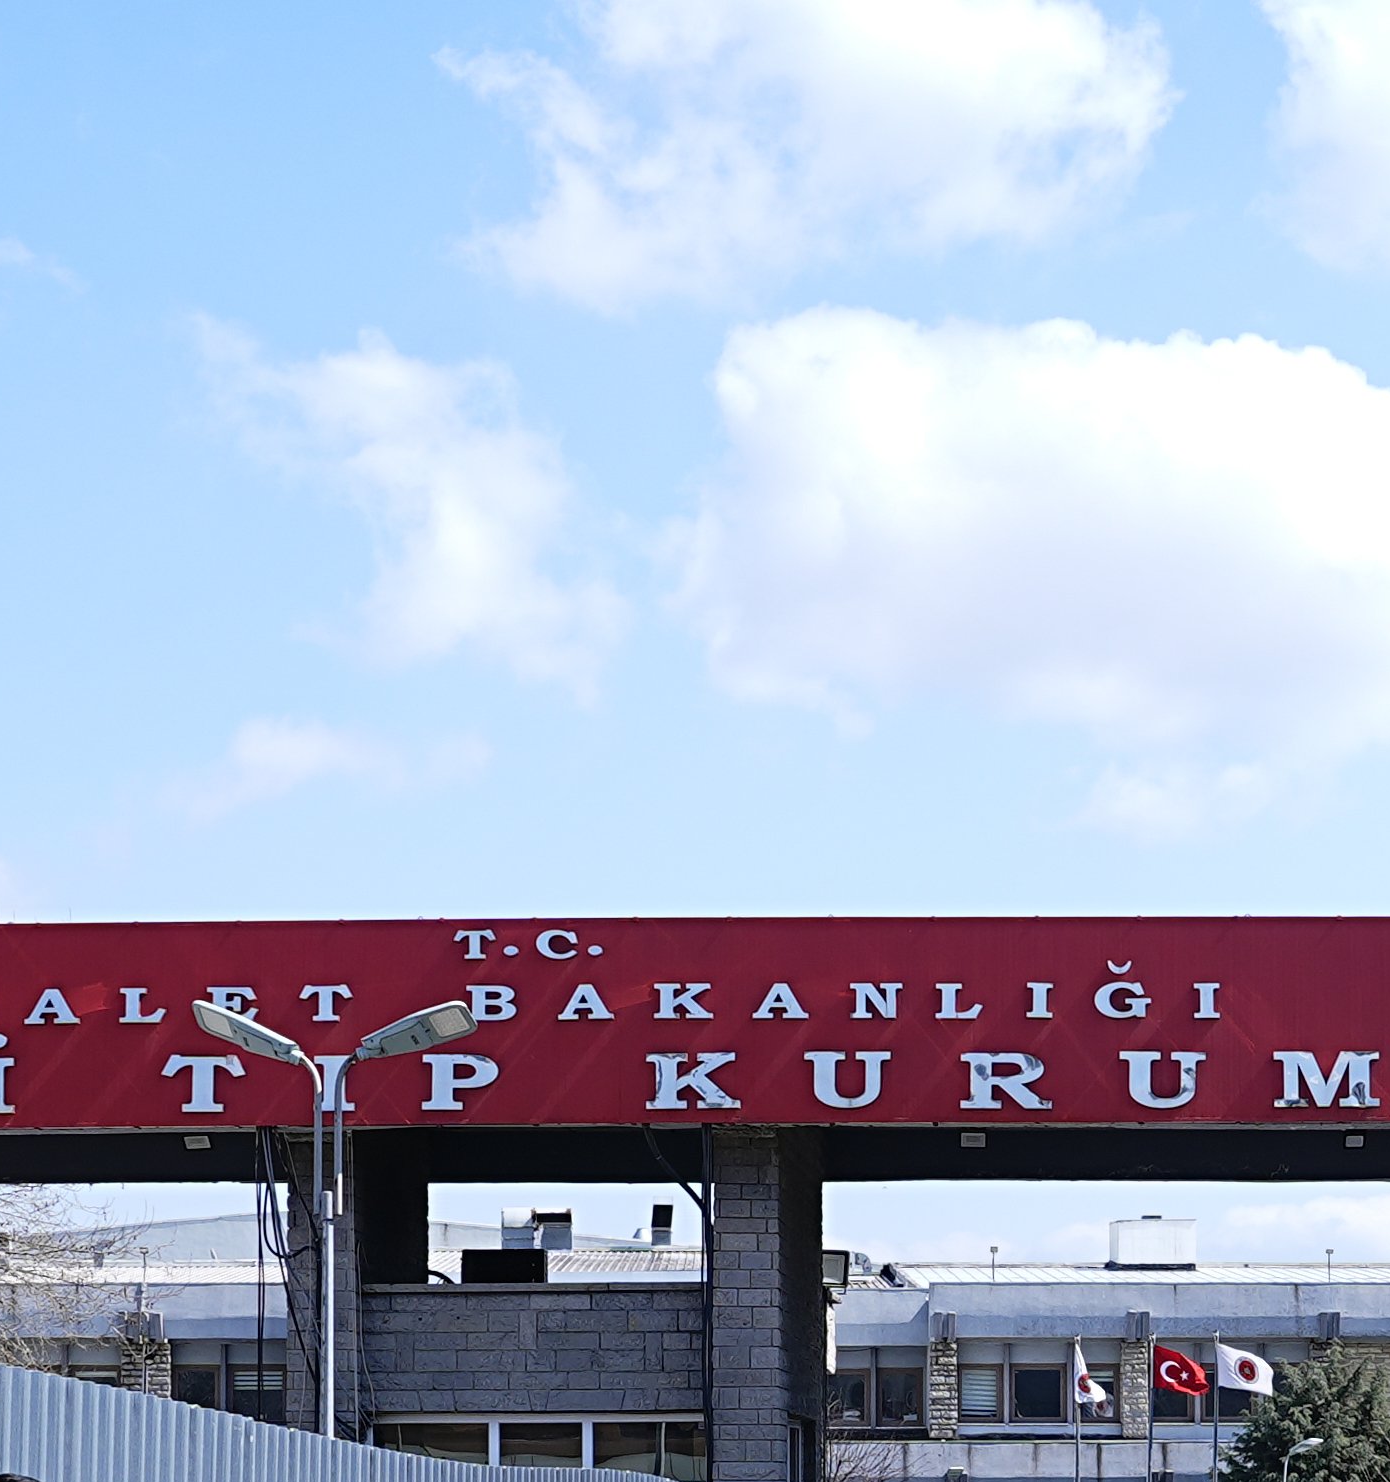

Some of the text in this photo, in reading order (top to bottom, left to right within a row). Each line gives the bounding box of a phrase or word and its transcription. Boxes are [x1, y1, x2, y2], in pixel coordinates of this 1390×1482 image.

[454, 929, 603, 960] T.C.
[466, 960, 1222, 1022] BAKANLIĞI
[161, 1053, 499, 1113] TIP
